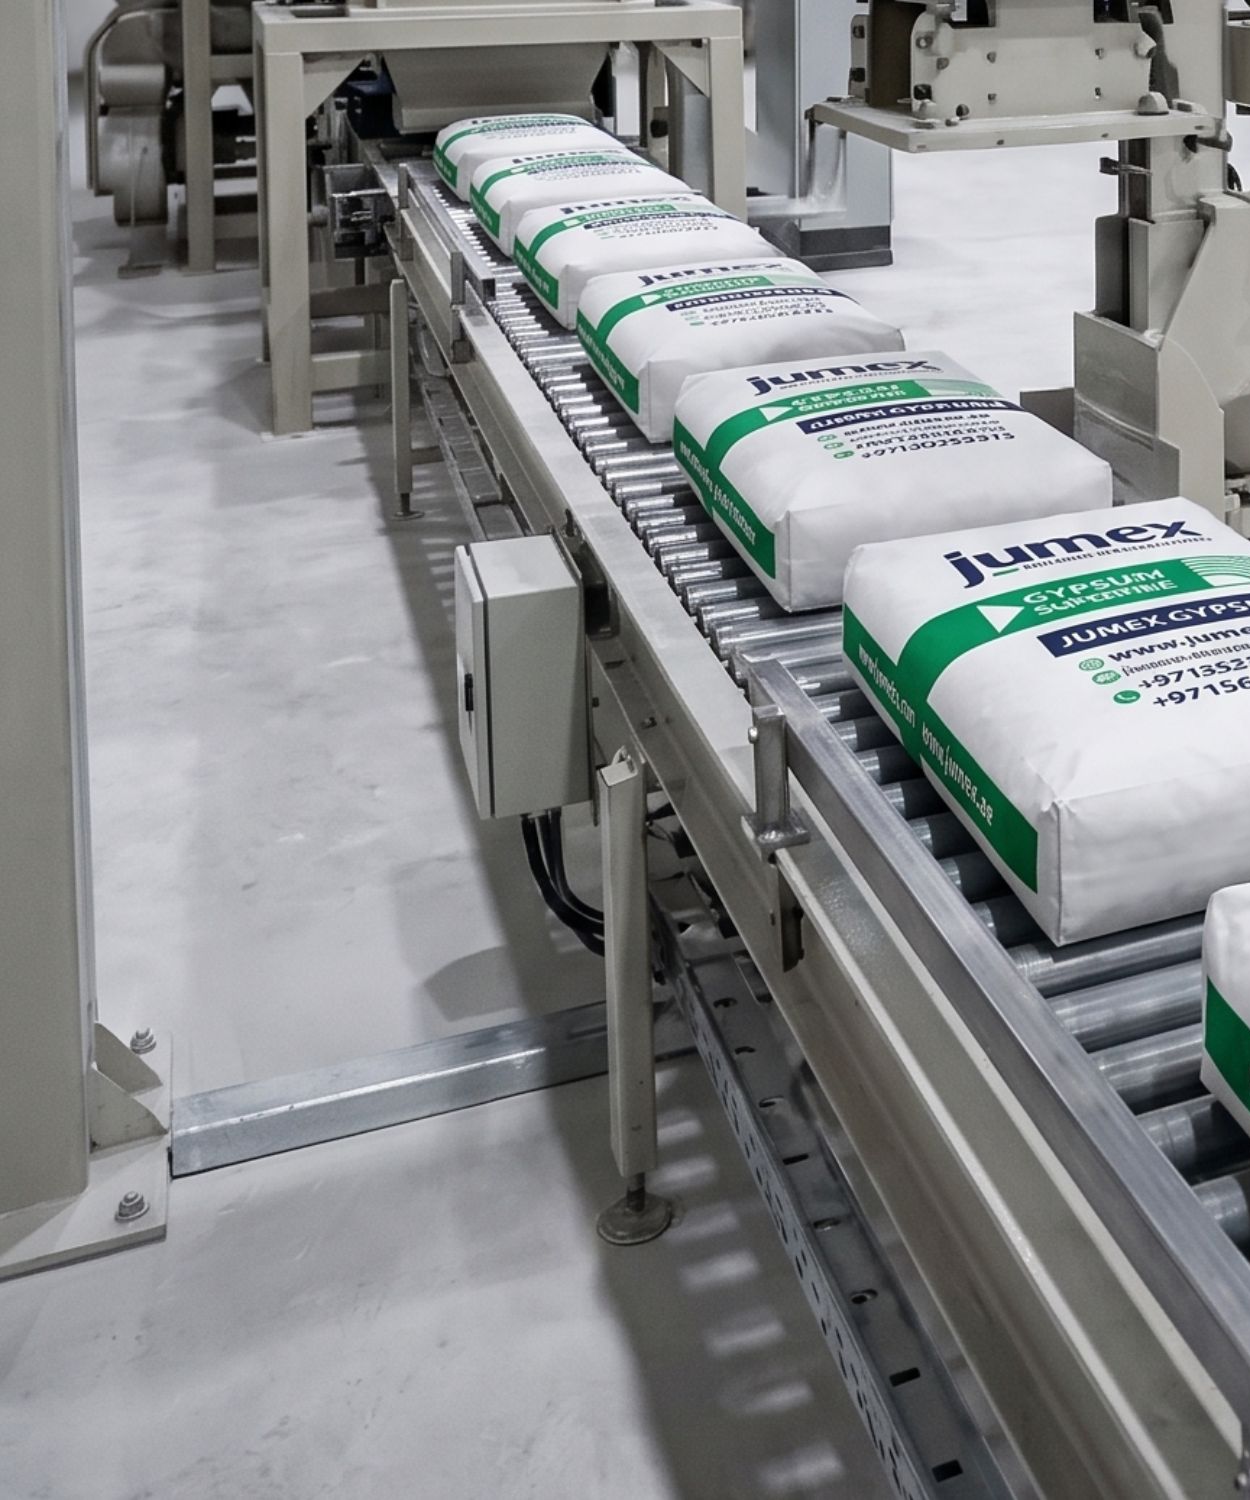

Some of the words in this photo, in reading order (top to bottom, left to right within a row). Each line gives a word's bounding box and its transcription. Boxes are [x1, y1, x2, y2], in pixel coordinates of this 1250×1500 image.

[944, 520, 1202, 588] jumex
[1023, 569, 1165, 603] GYPSUM
[1059, 614, 1168, 648] JUMEX
